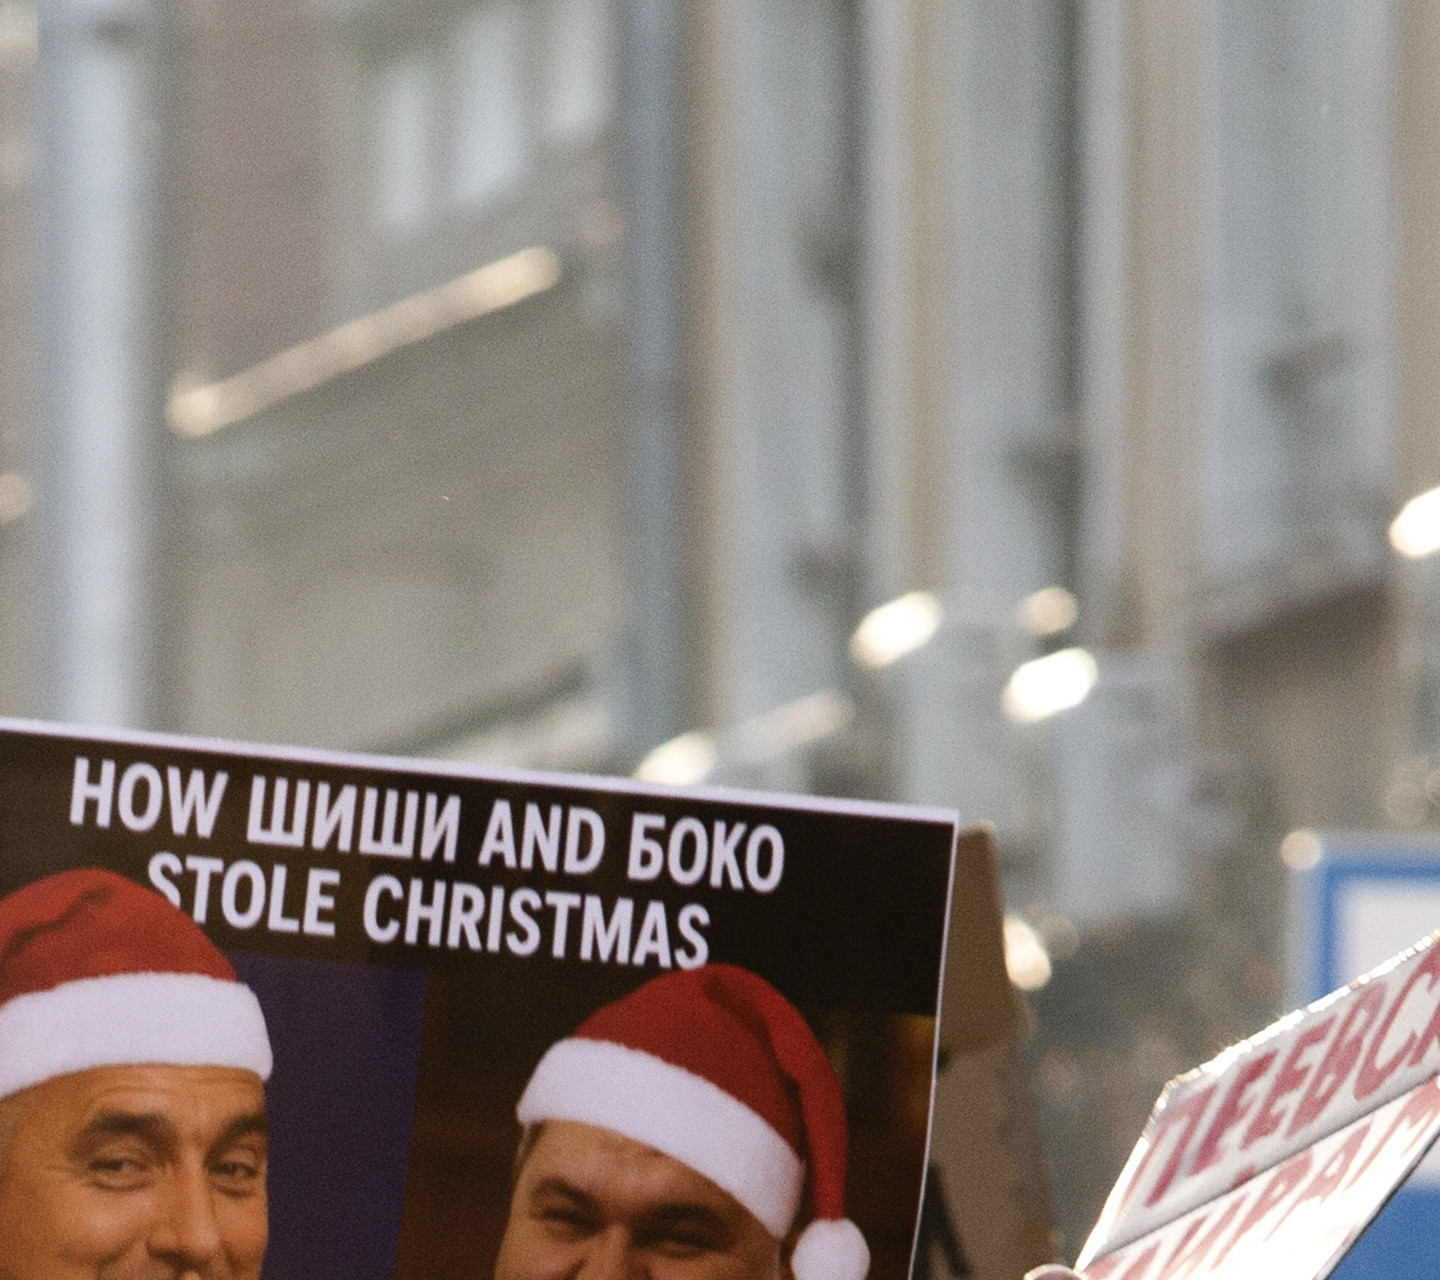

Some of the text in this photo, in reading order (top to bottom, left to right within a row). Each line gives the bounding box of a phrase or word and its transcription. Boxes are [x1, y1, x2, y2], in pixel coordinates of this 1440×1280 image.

[68, 757, 786, 896] HOW ШИШИ AND БОКО
[148, 852, 711, 973] STOLE CHRISTMAS
